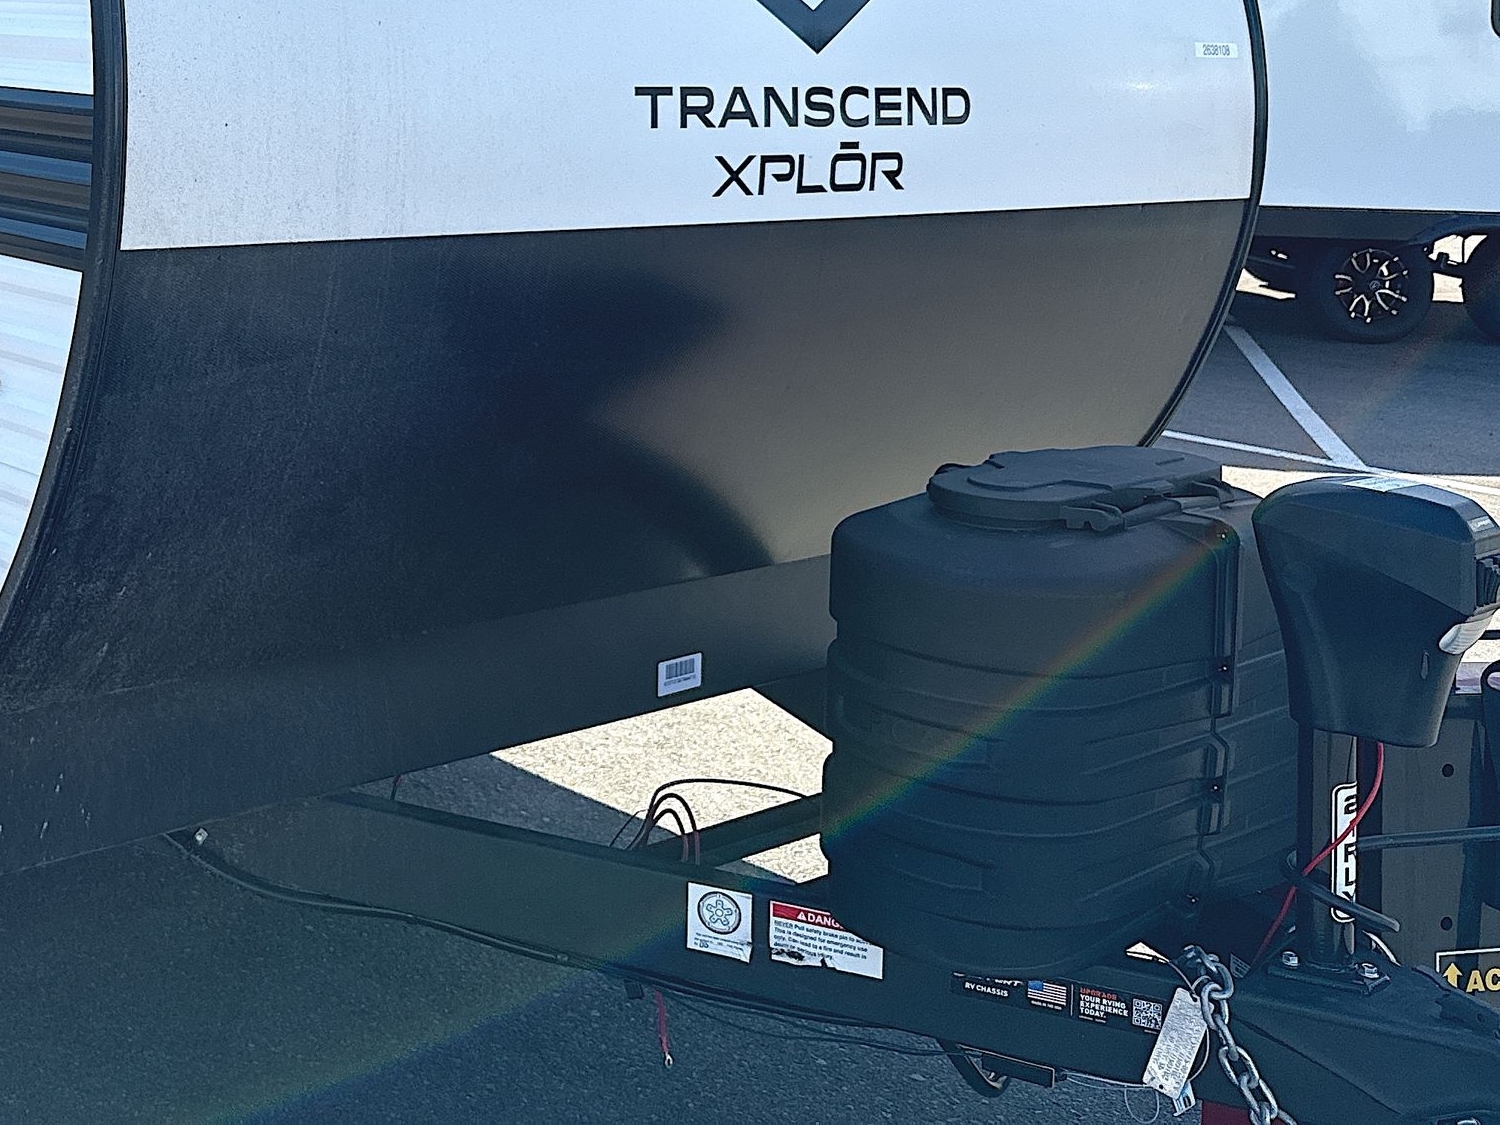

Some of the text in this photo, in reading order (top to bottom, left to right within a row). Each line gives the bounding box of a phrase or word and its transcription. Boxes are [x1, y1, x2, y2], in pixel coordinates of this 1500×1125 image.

[634, 85, 972, 129] TRANSCEND
[807, 913, 843, 930] DANG
[965, 982, 1009, 997] RV CHASSIS
[1080, 987, 1117, 1000] UPGRADE
[1080, 994, 1126, 1009] YOUR RVING
[1080, 1001, 1129, 1017] EXPERIENCE
[1080, 1007, 1107, 1019] TODAY.
